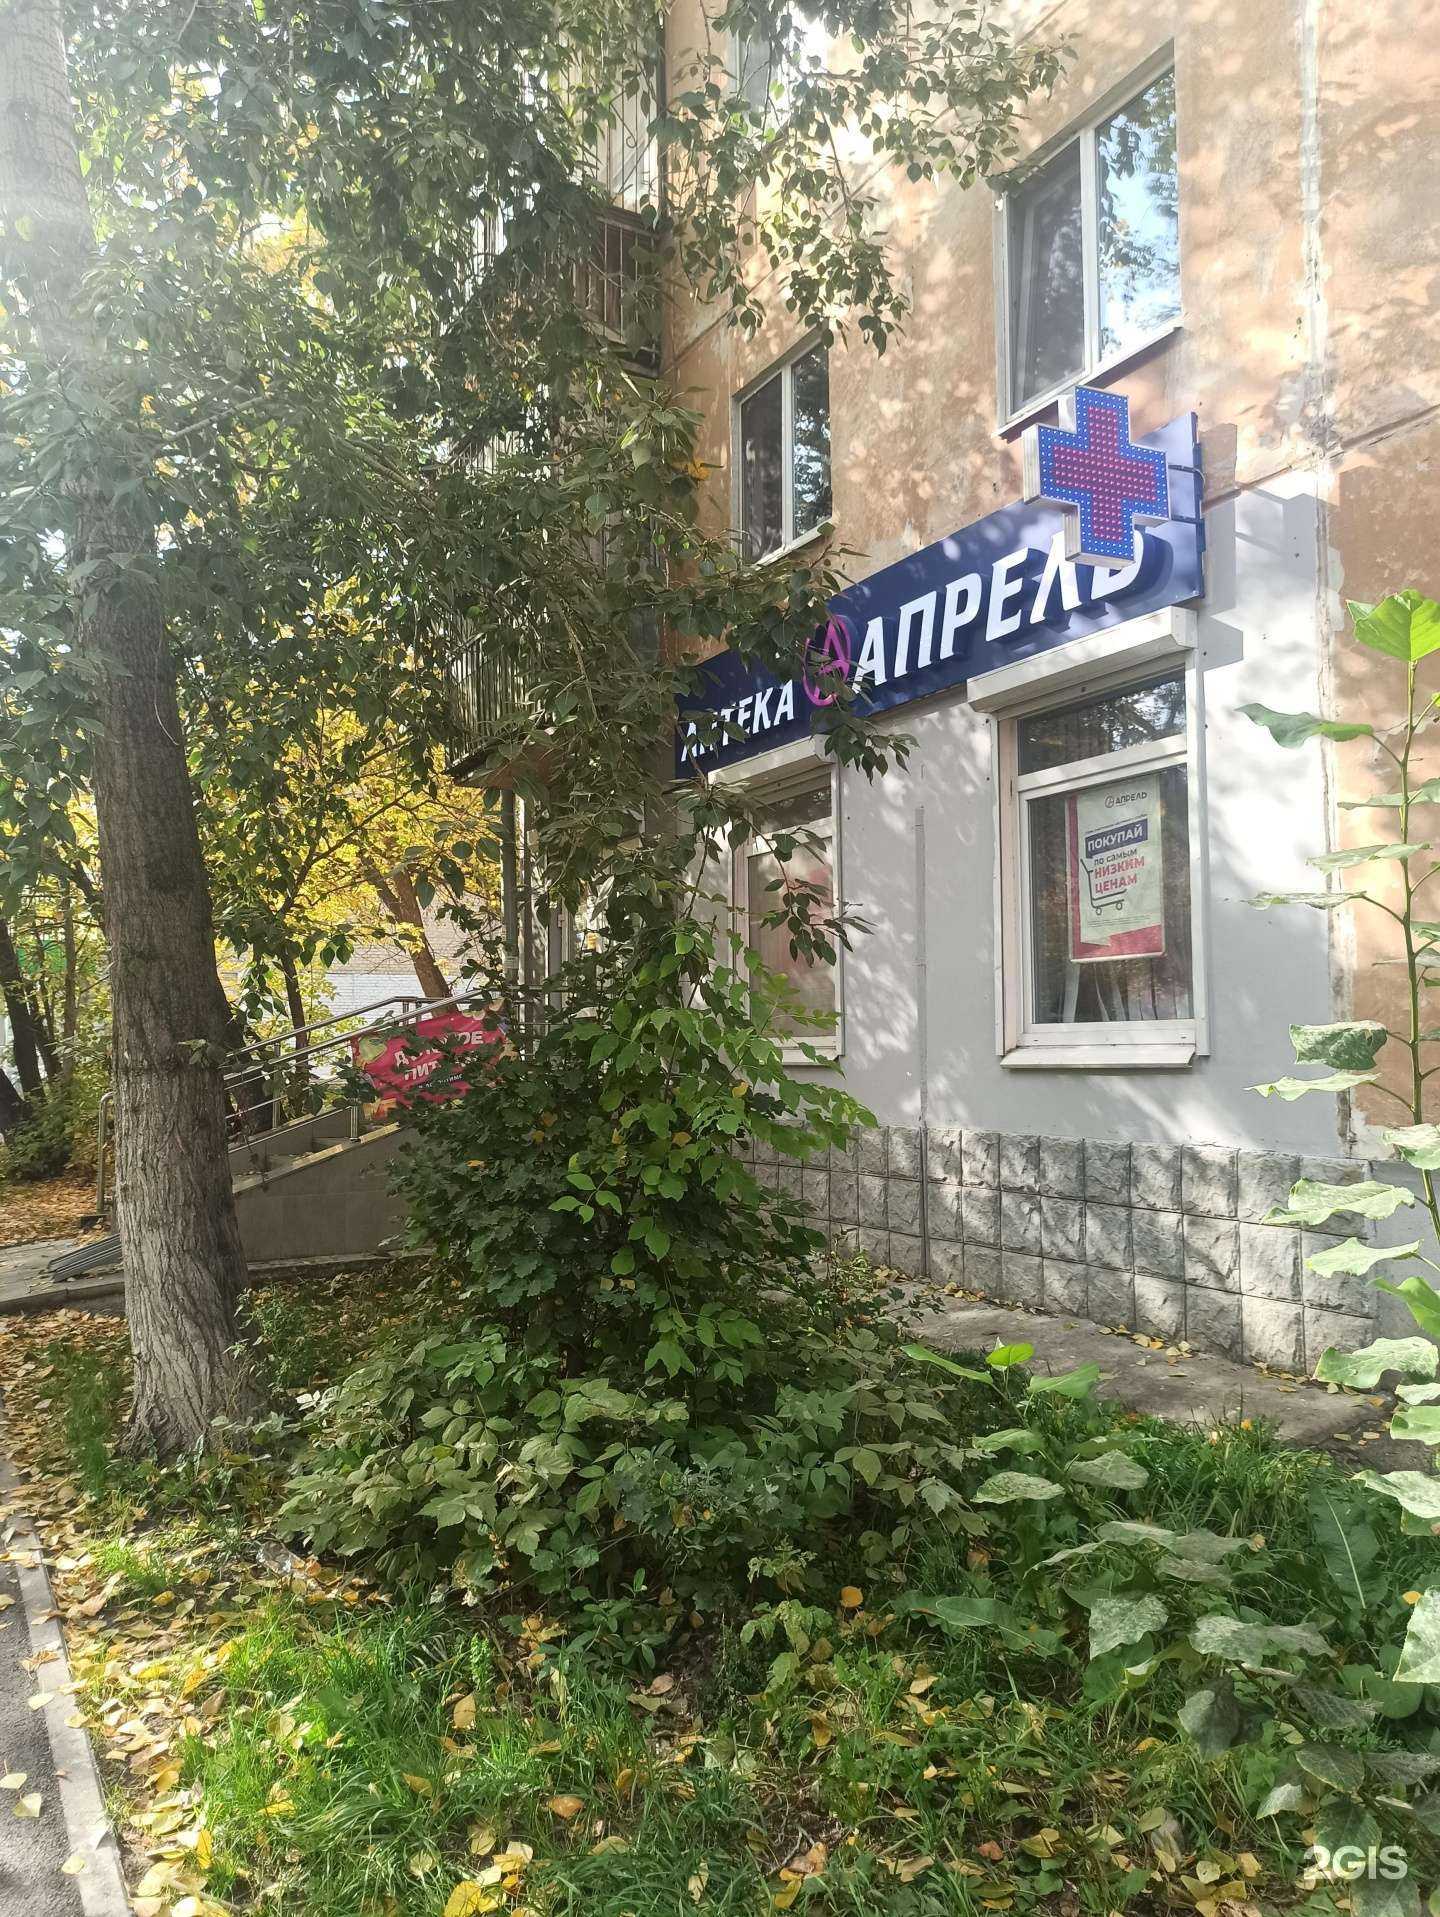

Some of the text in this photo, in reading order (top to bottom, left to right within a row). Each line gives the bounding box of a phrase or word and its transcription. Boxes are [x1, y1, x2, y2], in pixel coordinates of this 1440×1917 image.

[1115, 791, 1148, 804] АПРЕЛЬ
[1087, 823, 1143, 851] ПОКУПАЙ
[1094, 848, 1138, 866] по самым
[1094, 856, 1145, 879] НИЗКИМ
[1095, 876, 1138, 894] ЦЕНАМ
